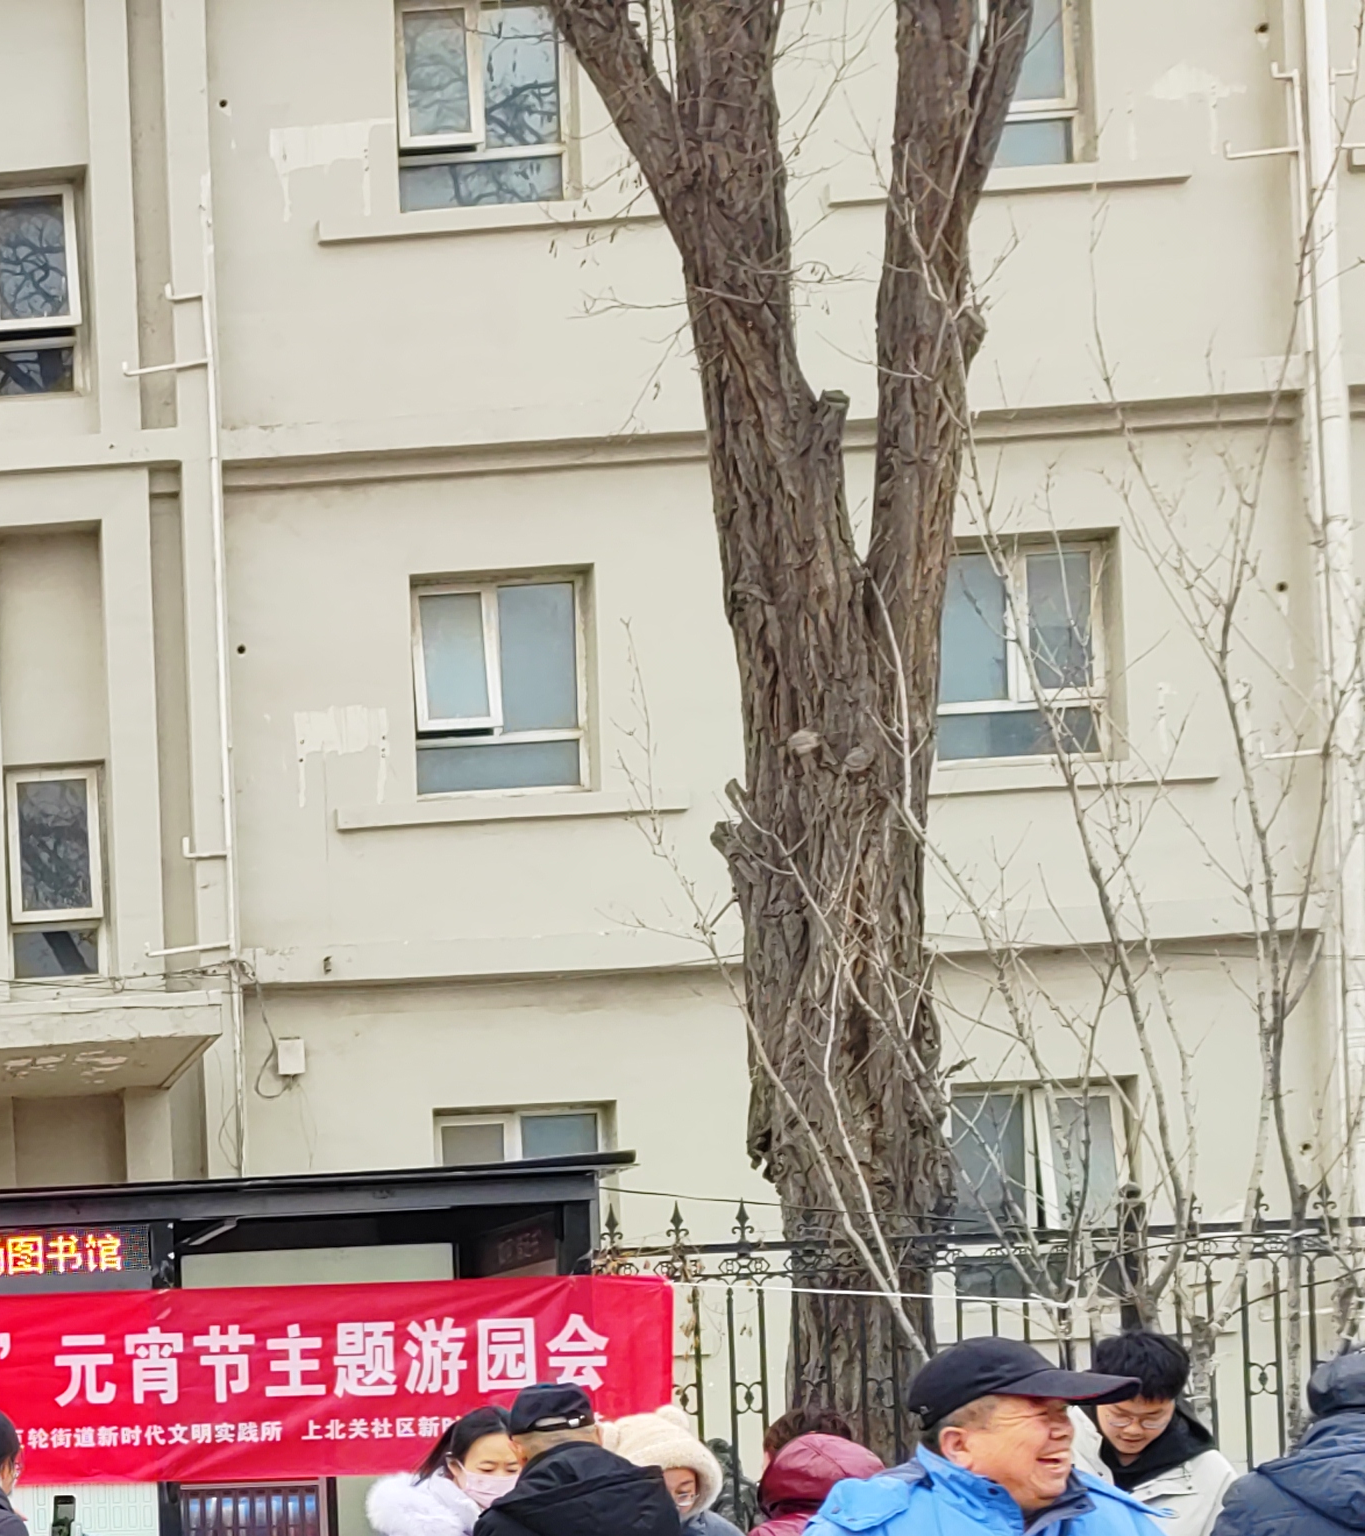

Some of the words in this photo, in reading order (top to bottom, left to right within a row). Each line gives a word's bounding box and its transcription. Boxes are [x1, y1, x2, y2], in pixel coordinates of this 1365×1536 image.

[54, 1313, 610, 1407] 元宵节主题游园会
